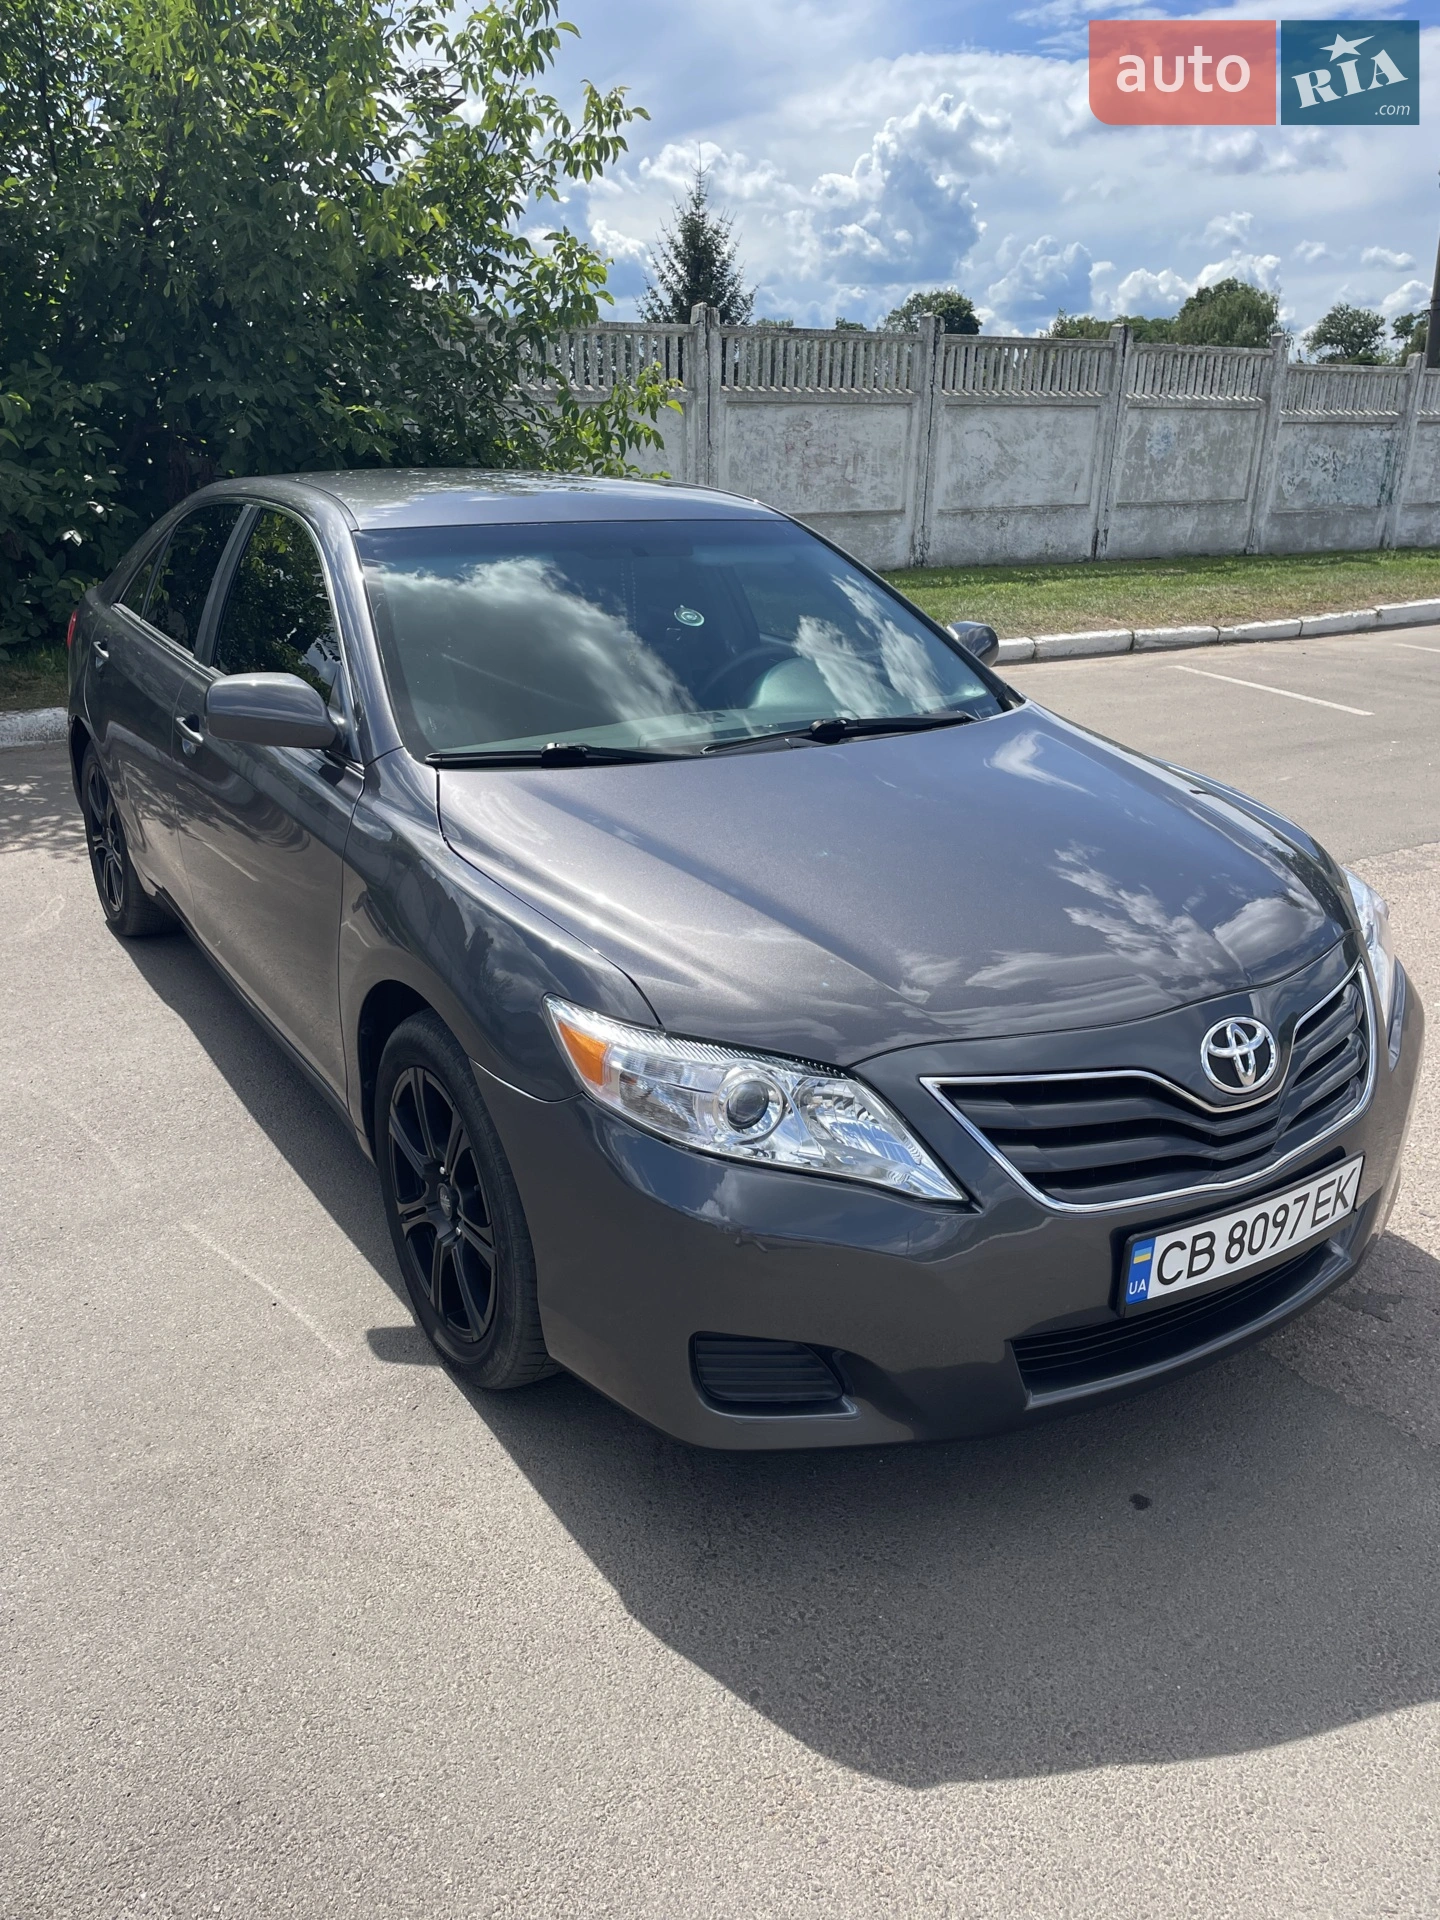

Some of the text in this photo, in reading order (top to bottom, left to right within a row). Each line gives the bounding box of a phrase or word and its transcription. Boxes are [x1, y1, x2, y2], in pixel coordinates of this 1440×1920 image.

[1157, 1166, 1358, 1286] CB 8097 EK
[1129, 1278, 1147, 1295] UA
